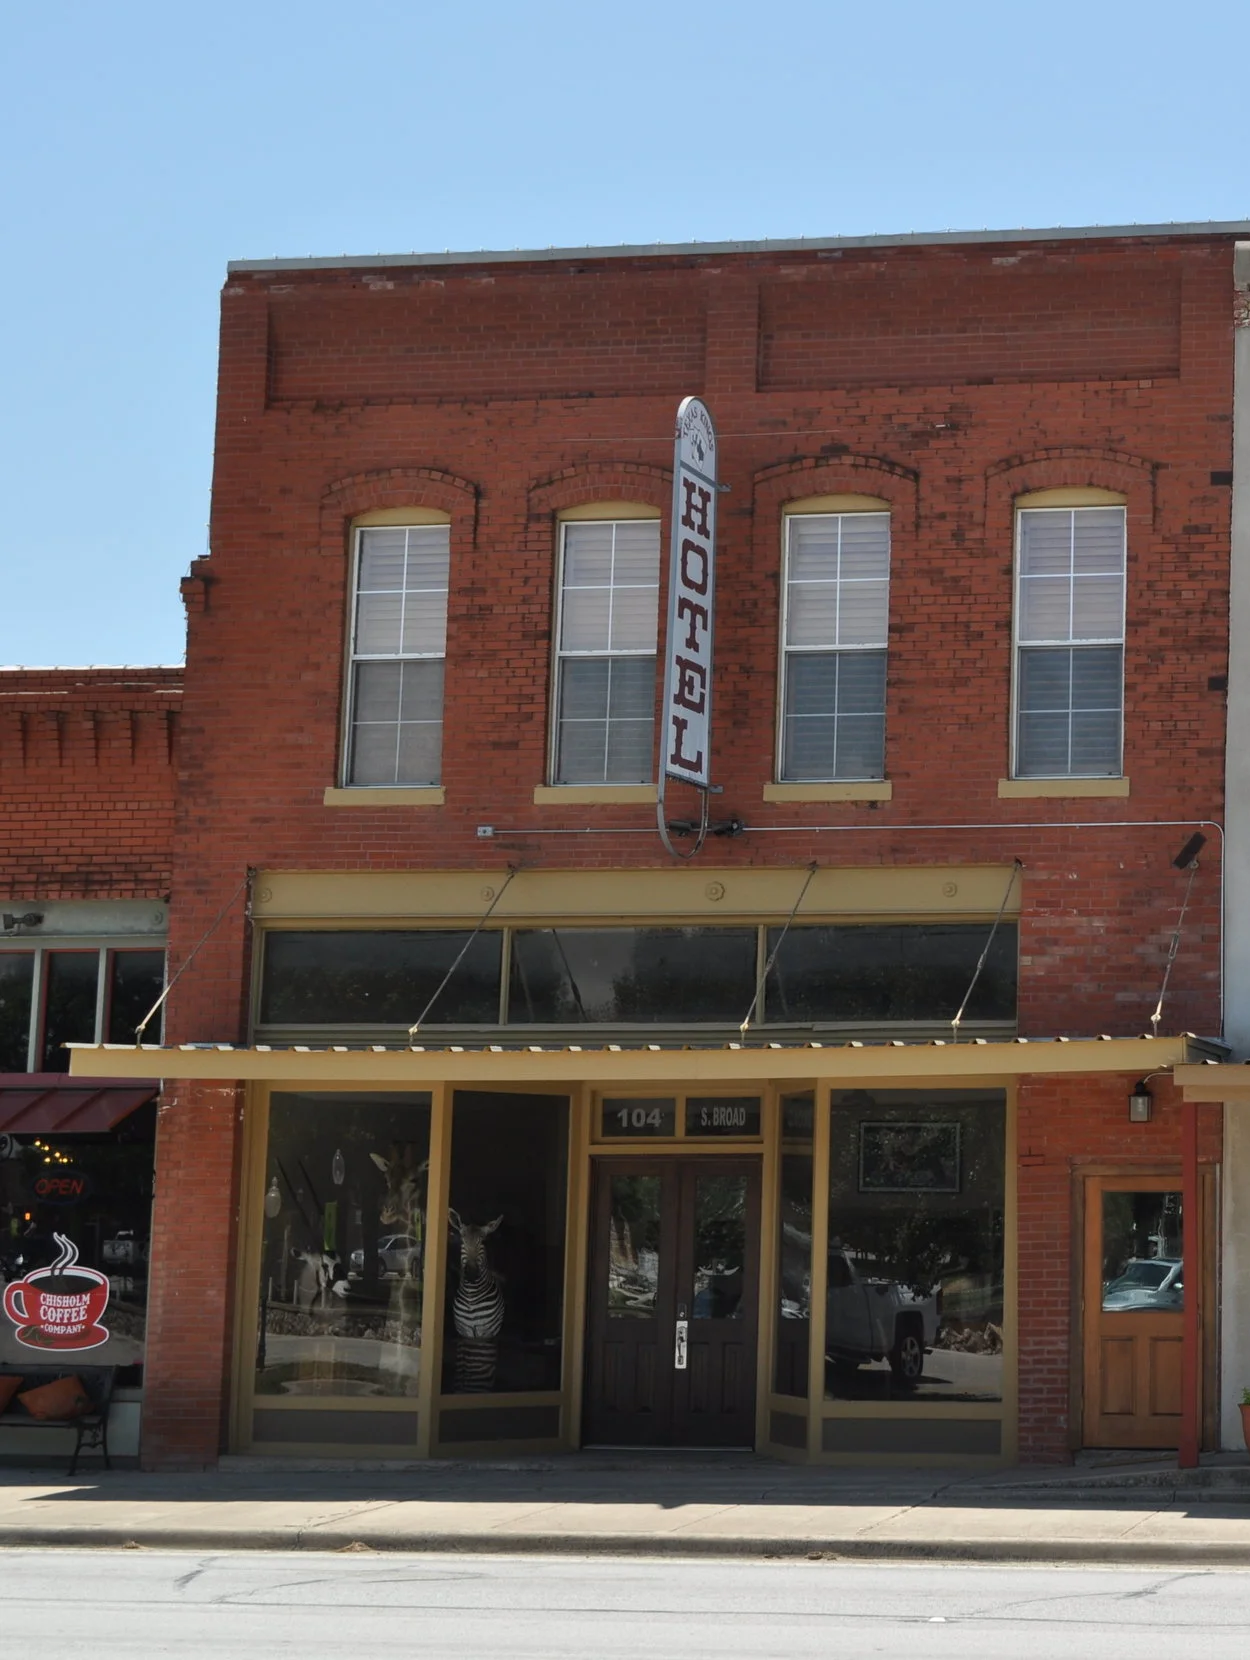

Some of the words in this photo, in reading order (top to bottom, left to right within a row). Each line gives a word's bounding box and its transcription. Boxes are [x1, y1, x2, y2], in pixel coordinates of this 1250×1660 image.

[682, 406, 698, 438] TEXAS
[700, 410, 714, 452] KINGS
[670, 476, 711, 774] HOTEL
[617, 1107, 662, 1127] 104
[701, 1107, 711, 1126] S.
[713, 1107, 746, 1126] BROAD
[35, 1178, 84, 1195] OPEN
[40, 1293, 91, 1308] CHISHOLM
[40, 1305, 88, 1323] COFFEE
[43, 1324, 82, 1335] COMPANY
